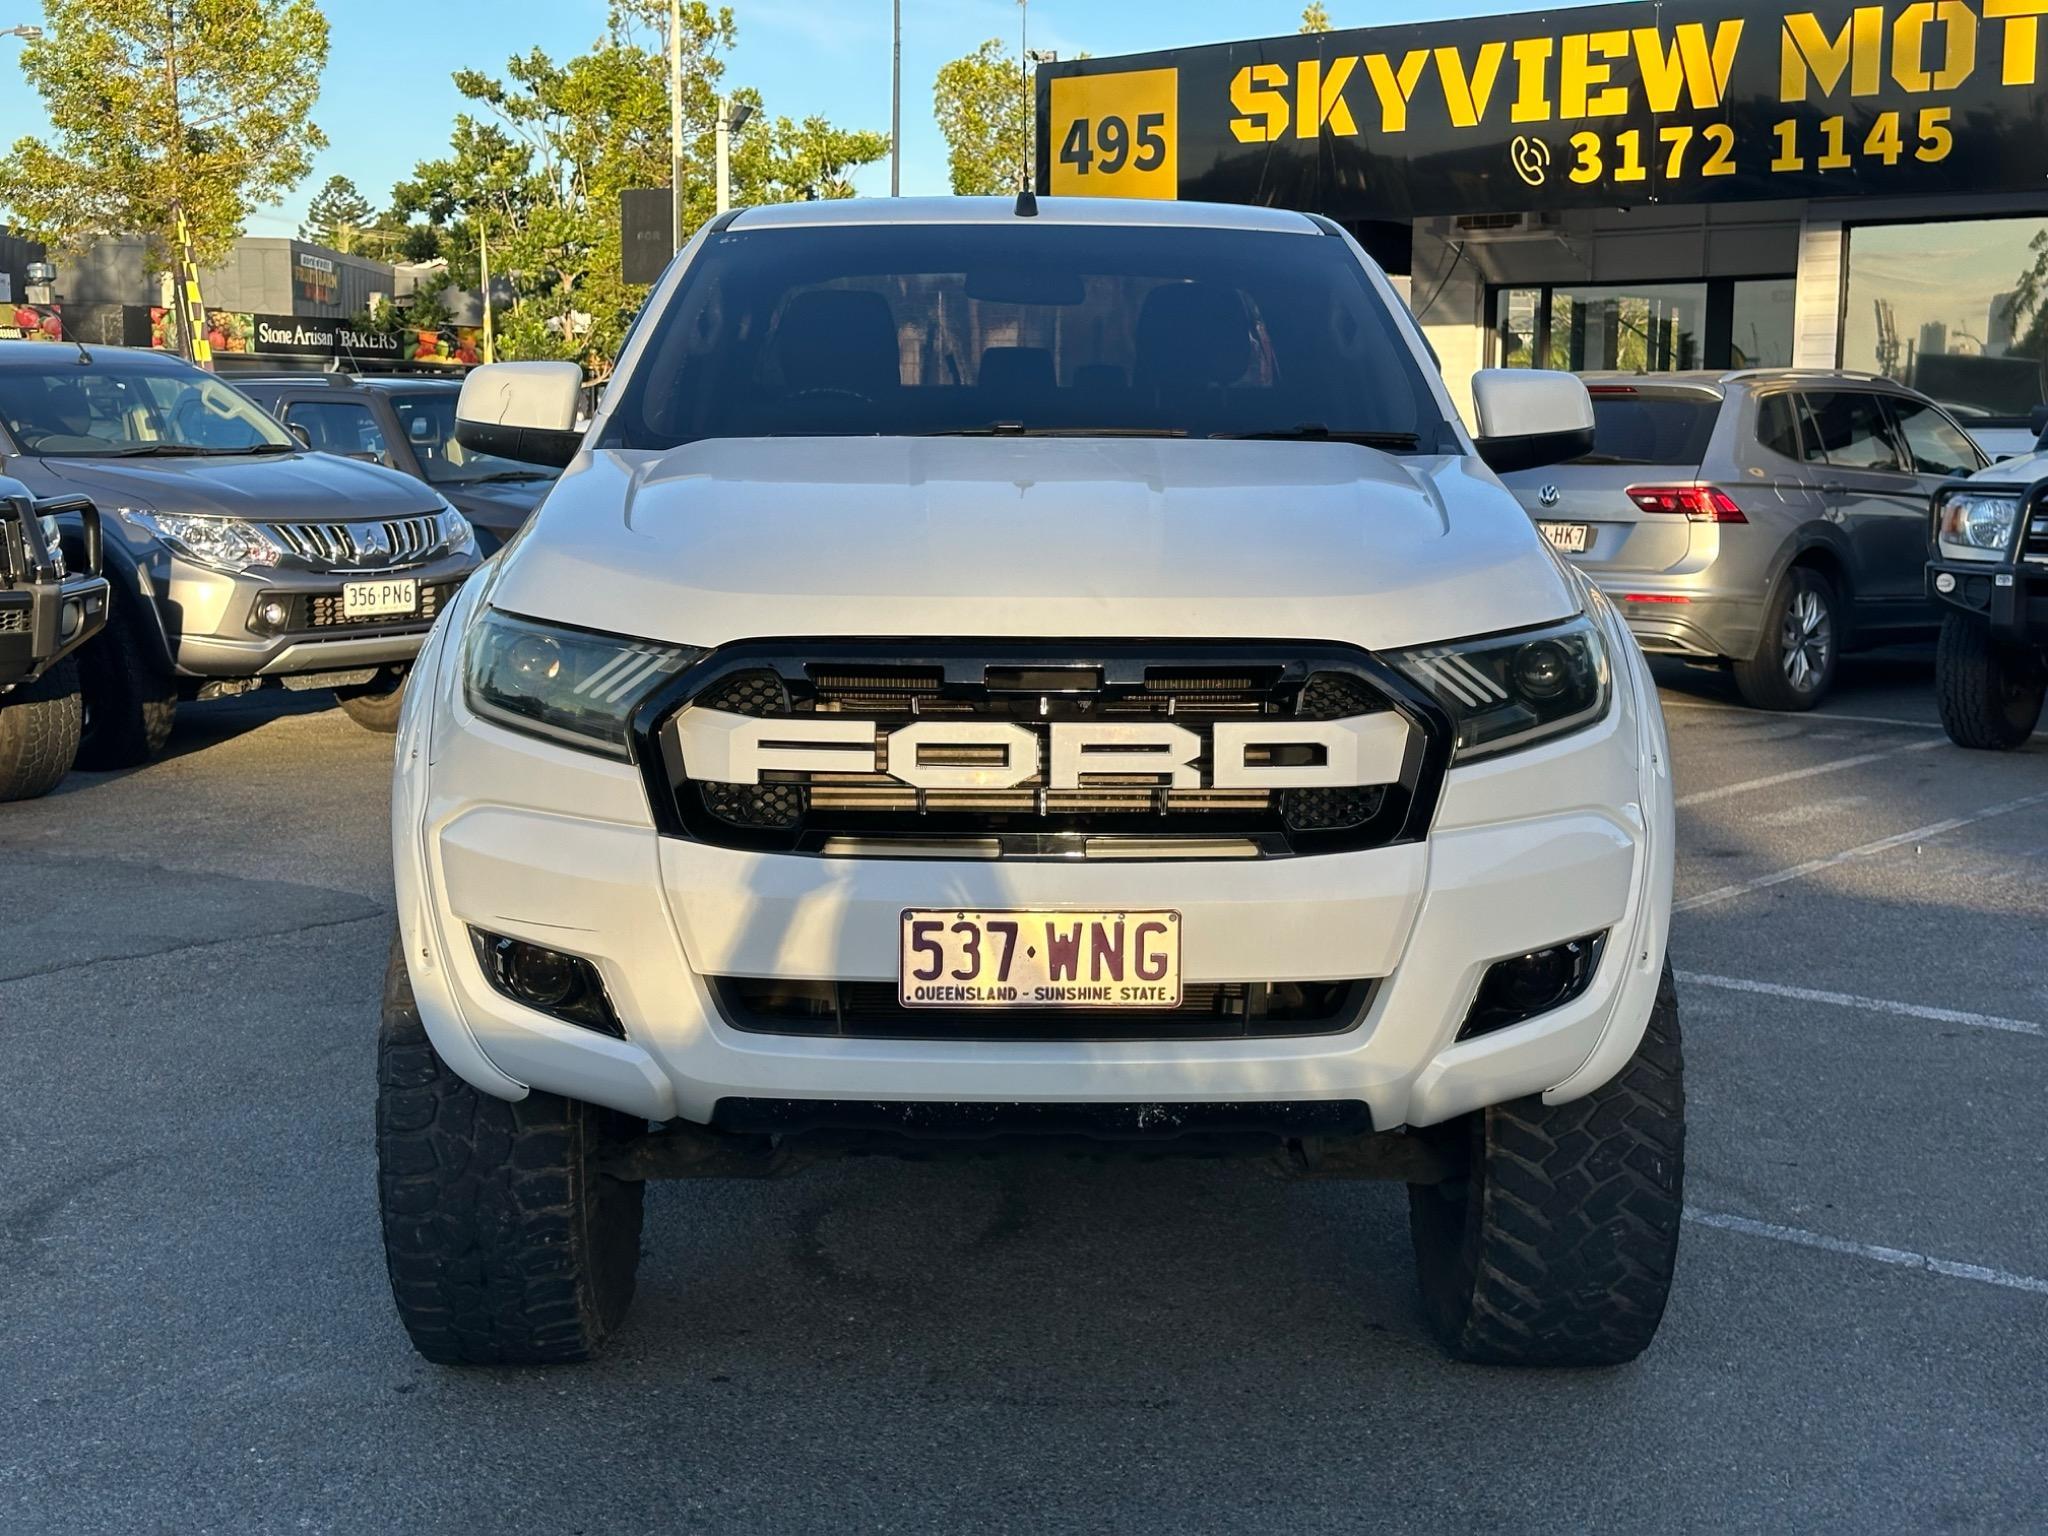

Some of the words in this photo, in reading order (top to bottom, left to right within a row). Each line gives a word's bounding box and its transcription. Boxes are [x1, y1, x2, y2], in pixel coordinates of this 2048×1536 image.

[1229, 18, 1745, 143] SKYVIEW
[1779, 0, 2048, 103] MOT
[1059, 112, 1166, 175] 495
[1568, 123, 1736, 184] 3172
[1770, 106, 1953, 173] 1145
[258, 322, 293, 344] Stone
[293, 324, 333, 346] Artisan
[676, 704, 1410, 790] FORD
[914, 985, 1018, 1001] QUEENSLAND
[1033, 985, 1112, 1001] SUNSHINE
[1120, 985, 1166, 1001] STATE
